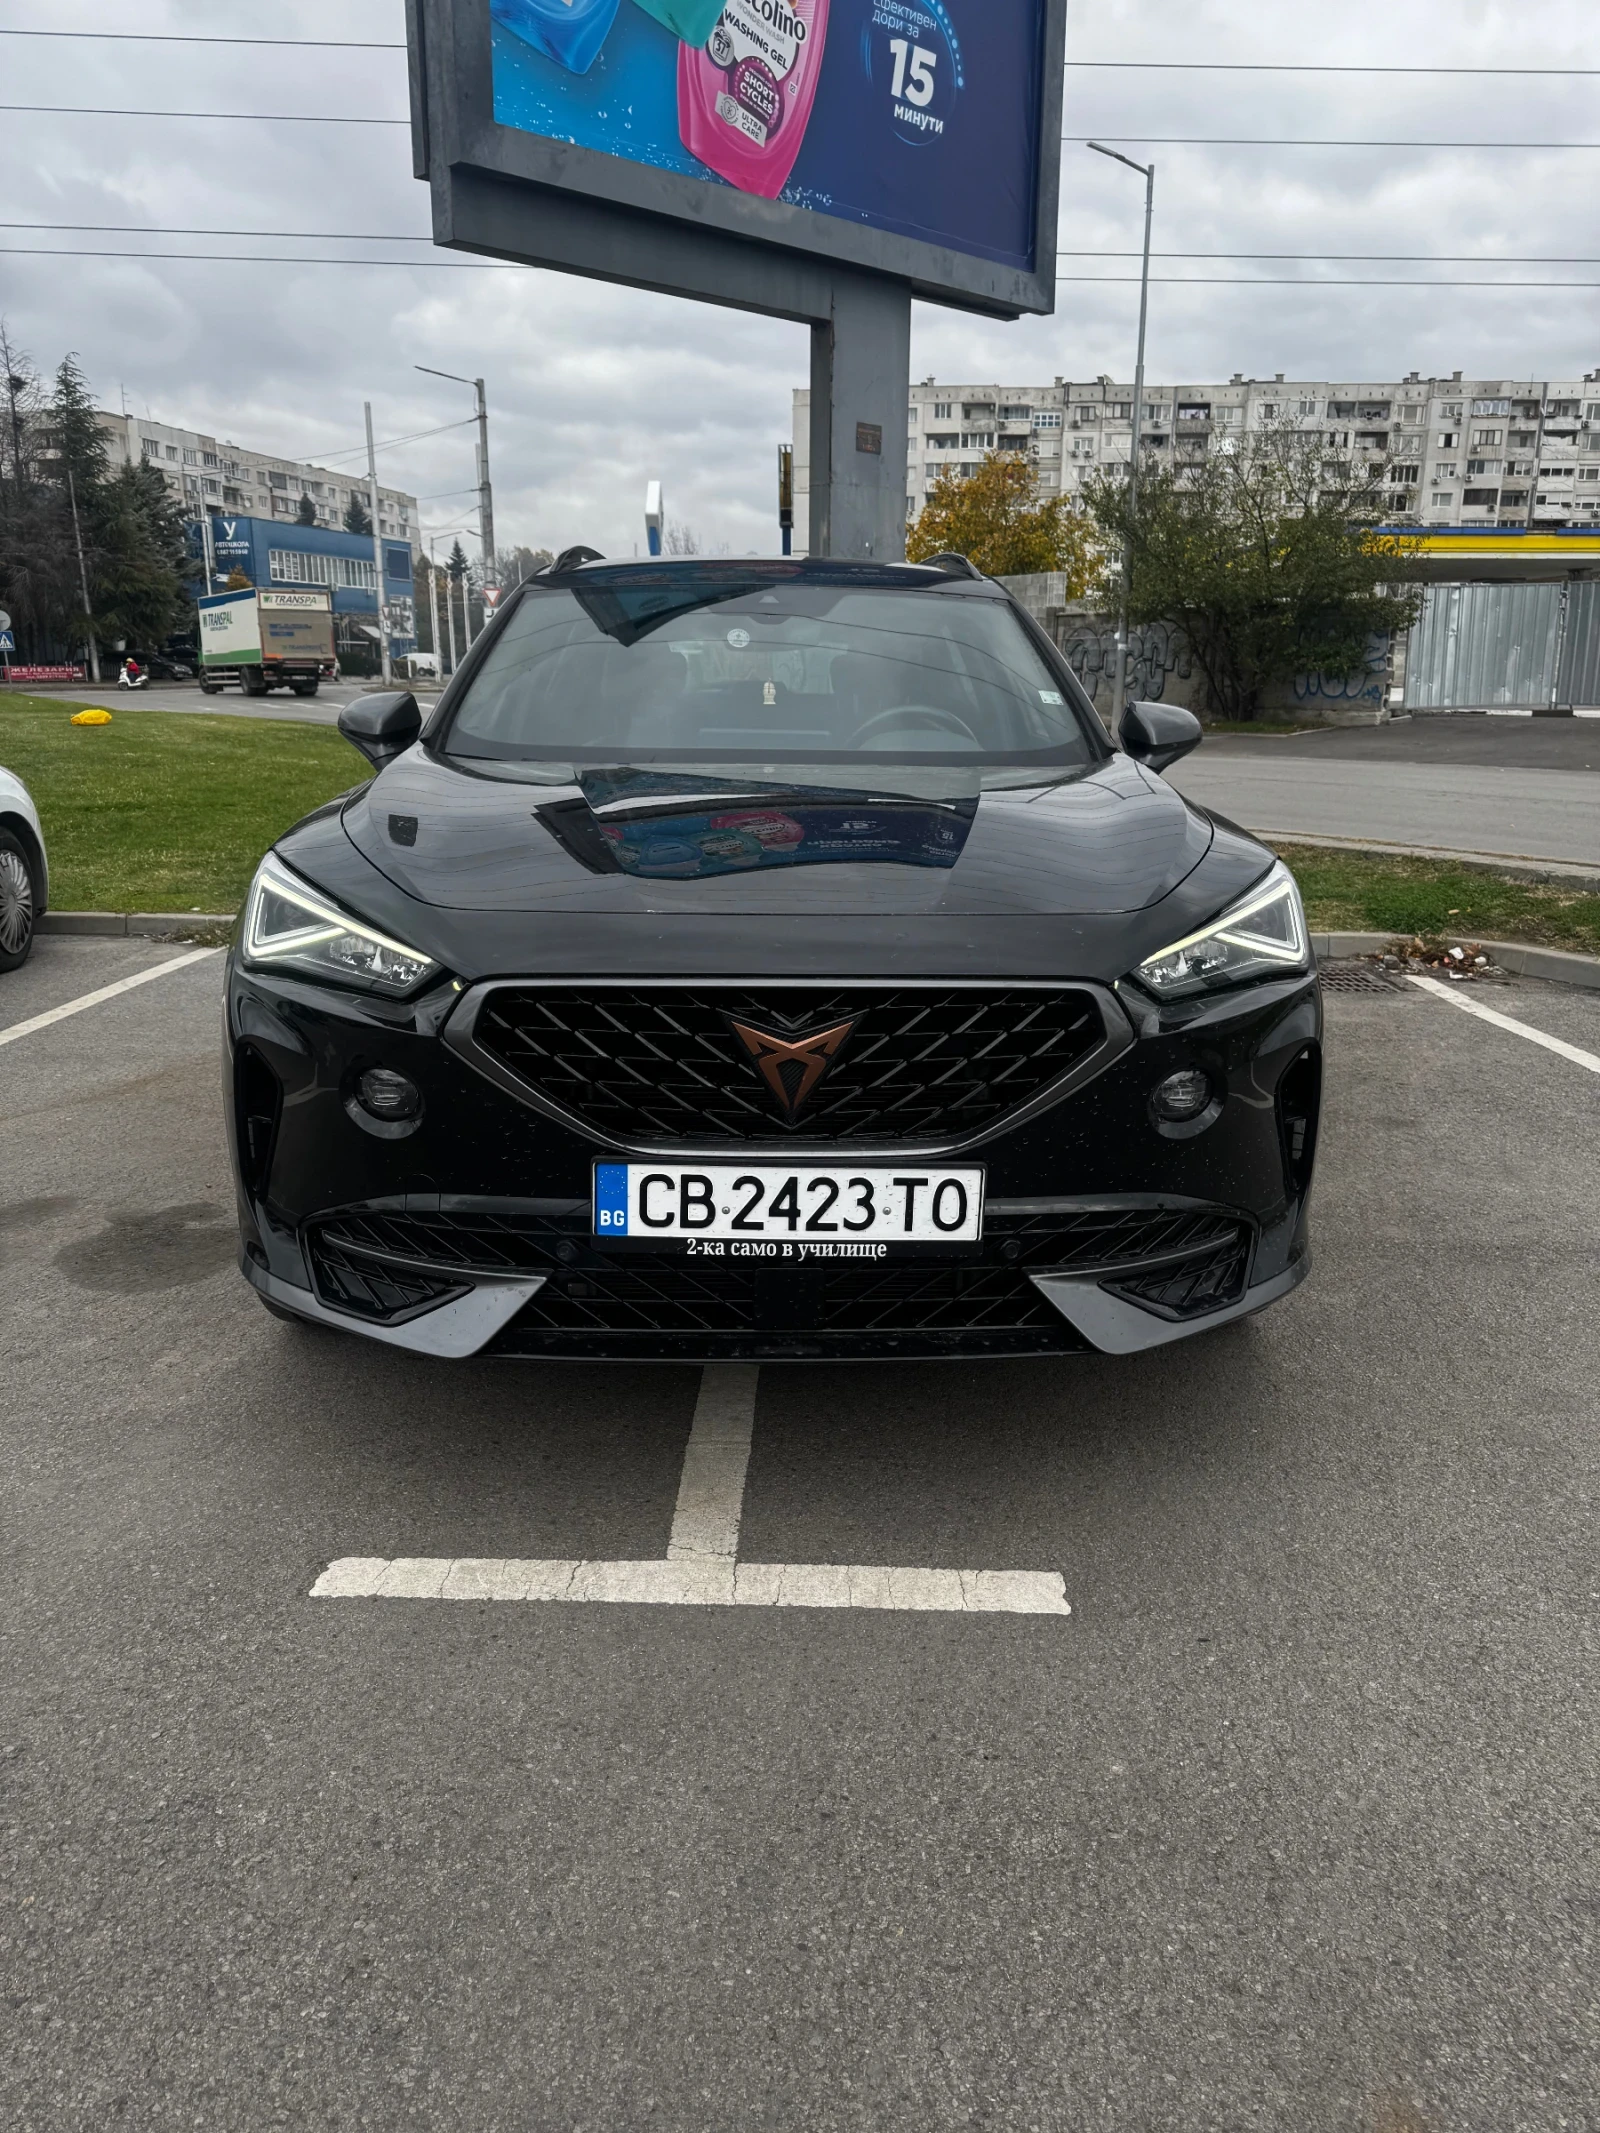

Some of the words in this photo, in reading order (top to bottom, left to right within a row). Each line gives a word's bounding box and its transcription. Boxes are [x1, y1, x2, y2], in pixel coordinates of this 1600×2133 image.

[737, 0, 765, 32] WONDER
[765, 28, 785, 44] WASH
[744, 0, 806, 41] colino
[872, 9, 903, 32] дори
[906, 23, 919, 38] за
[724, 8, 769, 53] WASHING
[770, 49, 788, 70] GEL
[744, 71, 774, 101] SHORT
[890, 38, 937, 107] 15
[740, 82, 774, 114] CYCLES
[742, 112, 762, 133] ULTRA
[742, 122, 760, 140] CARE
[894, 104, 944, 134] минути
[208, 611, 233, 627] TRANSPAL
[600, 1210, 625, 1226] BG
[639, 1174, 716, 1229] CB
[731, 1175, 876, 1231] 2423
[893, 1177, 967, 1232] TO
[686, 1238, 725, 1255] 2-ка
[731, 1242, 777, 1257] само
[782, 1243, 793, 1257] в
[798, 1243, 887, 1261] училище
